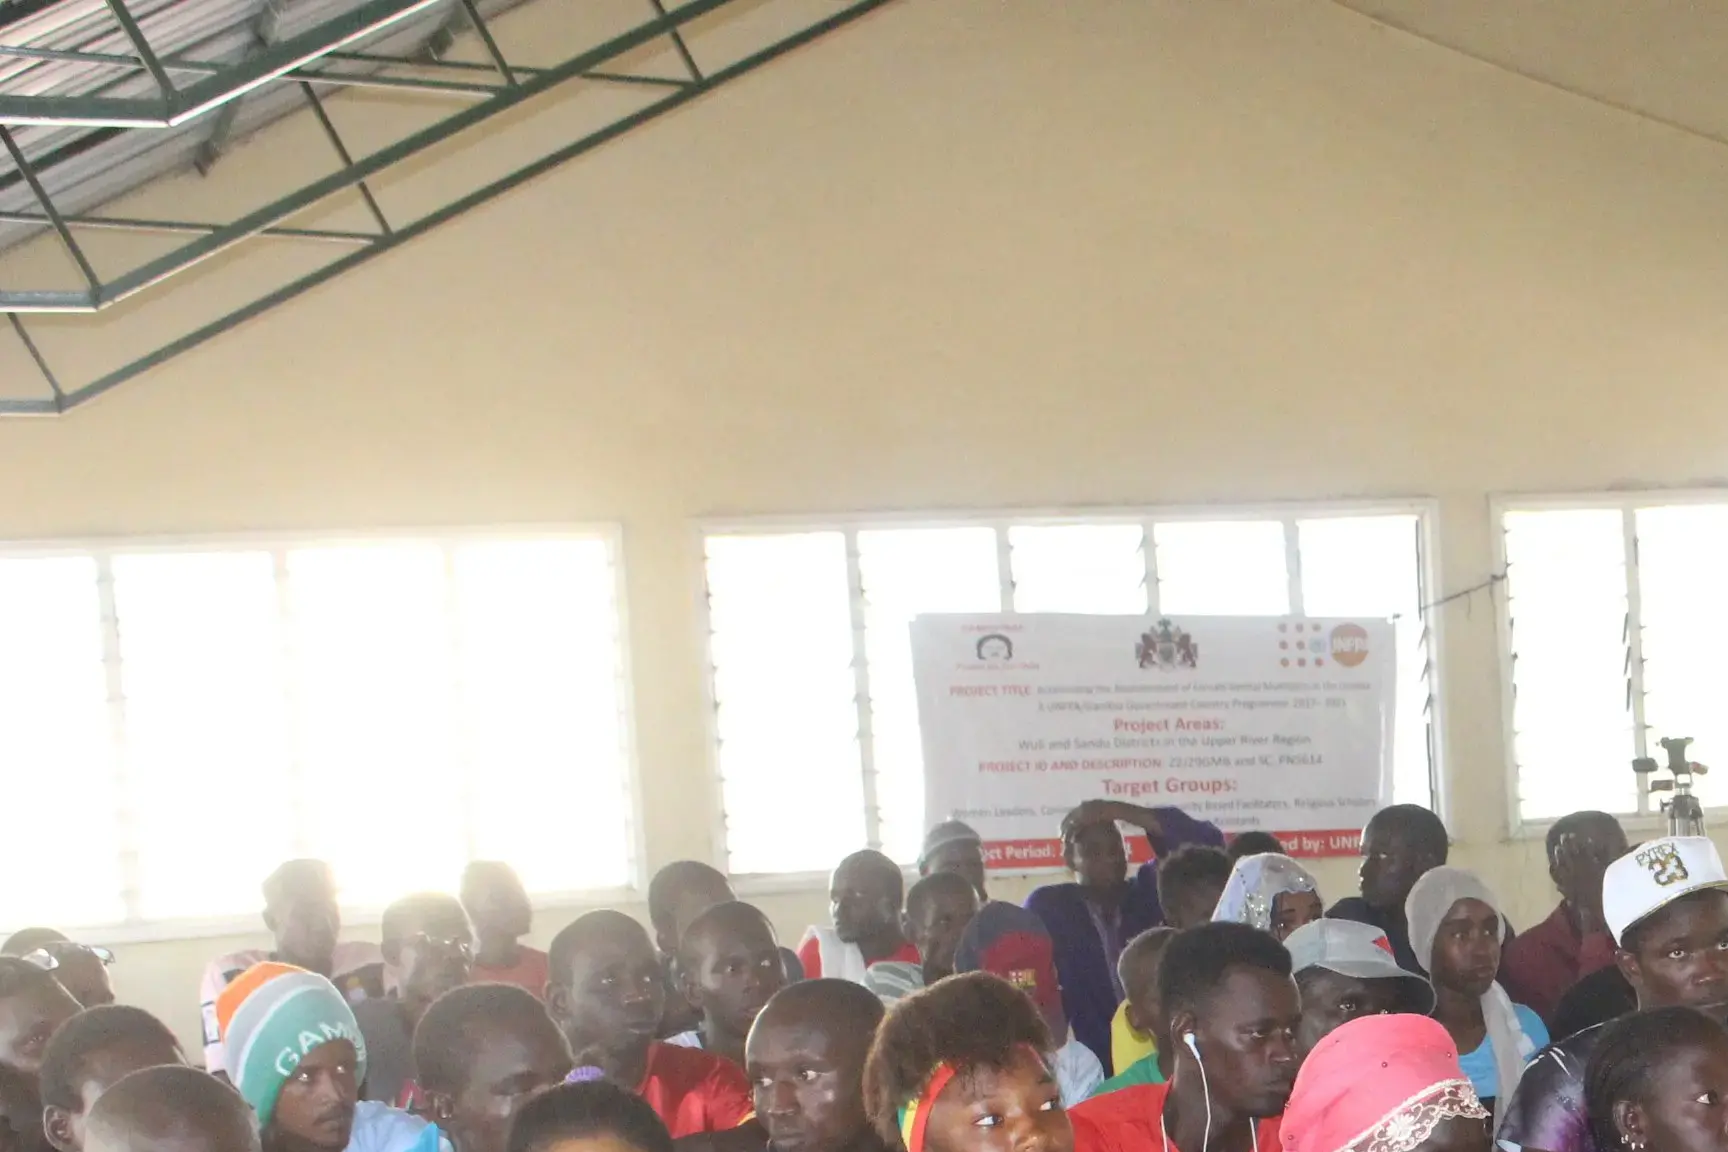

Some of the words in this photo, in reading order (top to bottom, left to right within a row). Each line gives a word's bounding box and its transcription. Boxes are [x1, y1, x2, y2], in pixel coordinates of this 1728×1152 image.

[950, 685, 997, 697] PROJECT
[1113, 718, 1169, 734] Project
[1175, 717, 1226, 731] Areas:
[1050, 739, 1071, 750] and
[1201, 735, 1237, 748] Upper
[1240, 735, 1269, 746] River
[1272, 733, 1312, 746] Region
[978, 761, 1030, 773] PROJECT
[1051, 760, 1079, 771] AND
[1101, 778, 1160, 797] Target
[1165, 776, 1238, 794] Groups:
[1005, 843, 1056, 860] Period:
[1302, 837, 1325, 853] by:
[1635, 842, 1681, 866] PYREX
[1648, 853, 1689, 886] 23
